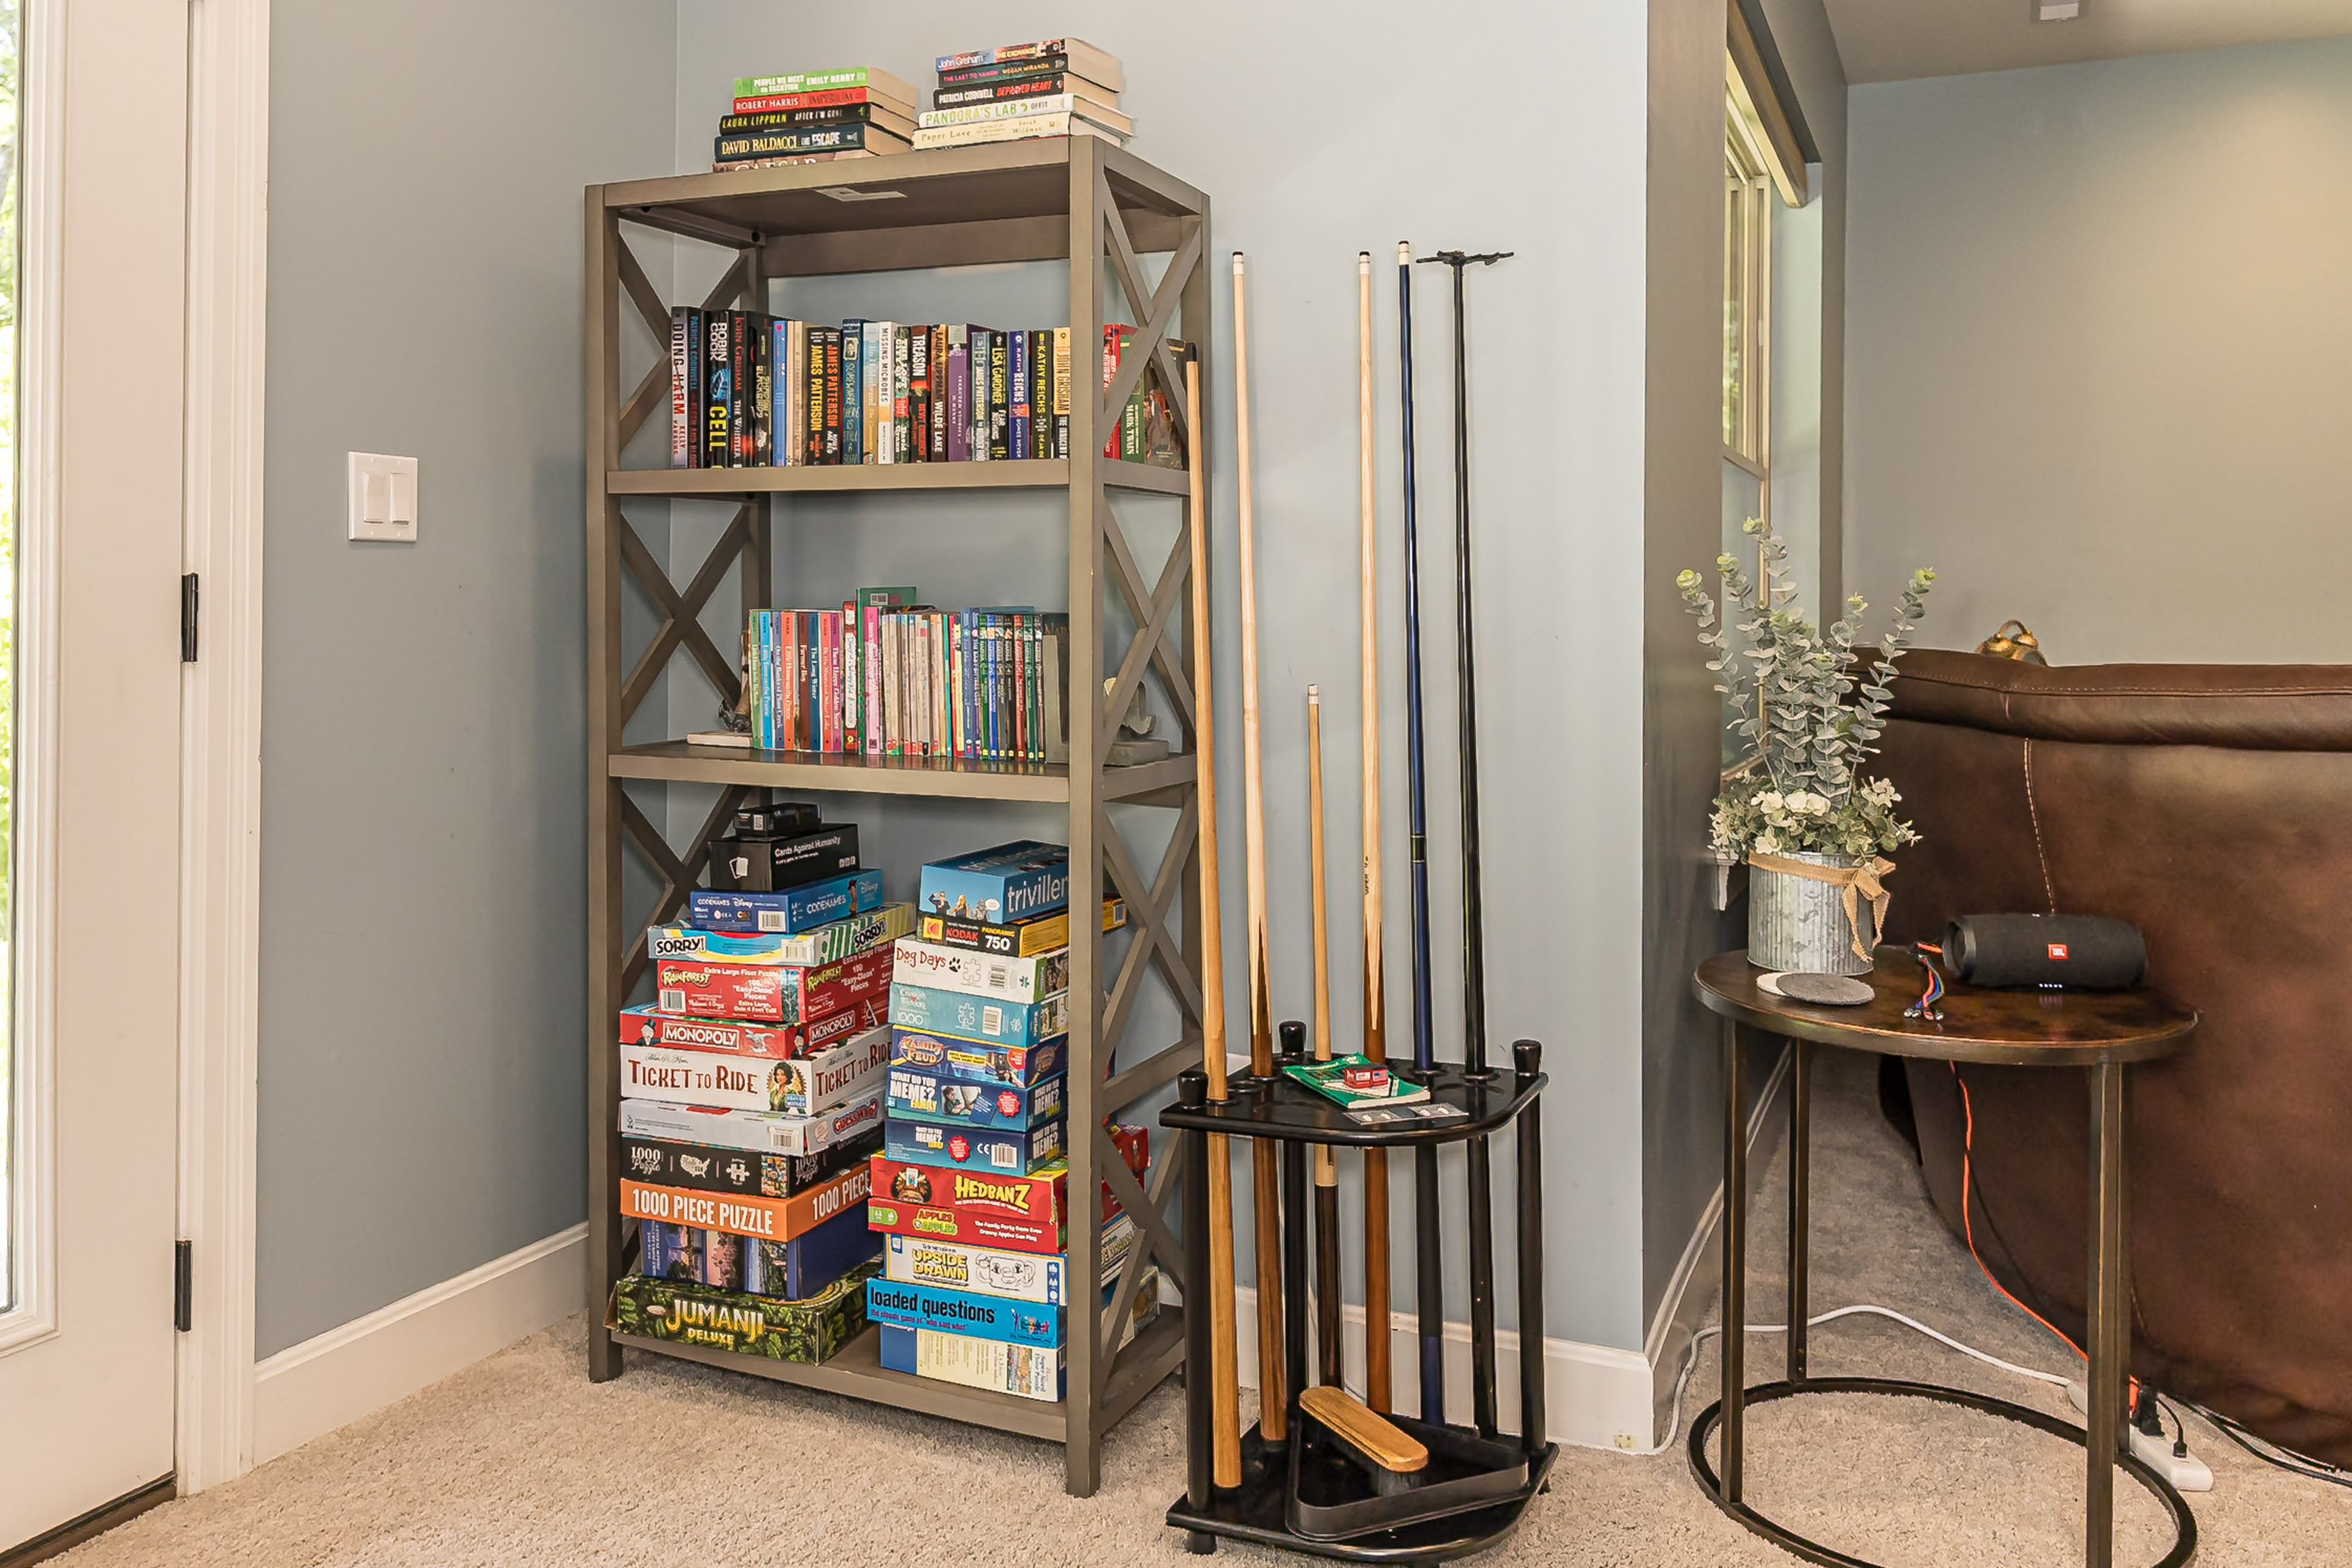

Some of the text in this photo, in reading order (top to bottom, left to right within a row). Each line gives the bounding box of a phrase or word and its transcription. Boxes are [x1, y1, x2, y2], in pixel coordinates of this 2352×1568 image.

[938, 55, 983, 68] John Grisham
[1024, 63, 1049, 71] MIRANDA
[754, 77, 786, 87] PEOPLE WE
[806, 73, 855, 86] EMILY HENRY
[997, 80, 1053, 96] DEPRAVED HEART
[736, 98, 798, 110] ROBERT HARRIS
[809, 93, 853, 106] IMPERIUM
[939, 89, 994, 104] PATRICIA CORNWELL
[1030, 101, 1048, 109] OFFIT
[722, 114, 786, 128] LAURA LIPPMAN
[925, 103, 1017, 126] PANDORA'S LAB
[721, 135, 797, 155] DAVID BALDACCI
[801, 132, 841, 146] THE ESCAPE
[922, 132, 947, 141] Paper
[950, 130, 970, 138] Love
[673, 324, 684, 366] DOING
[710, 323, 718, 361] COOK
[718, 323, 727, 361] ROBIN
[734, 317, 744, 390] JOHN GRISHAM
[912, 334, 925, 375] TREASON
[690, 351, 698, 390] CORNWELL
[935, 332, 943, 400] LAURA LIPPMAN
[827, 345, 838, 426] JAMES PATTERSON
[845, 362, 856, 405] SOMEWHERE
[992, 348, 1003, 404] LISA GARDNER
[1037, 346, 1045, 413] KATHY REICHS
[1057, 354, 1069, 411] JOHN GRISHAM
[811, 345, 822, 431] JAMES PATTERSON
[975, 367, 984, 420] JAMES PATTERSON
[1014, 373, 1023, 402] REICHS
[709, 406, 727, 451] CELL
[934, 401, 943, 453] WILDE LAKE
[1126, 405, 1134, 454] MARK TWAIN
[734, 417, 742, 458] WHISTLER
[775, 837, 841, 857] Cards Against Humanity
[858, 881, 878, 893] Disney
[732, 897, 753, 908] Disney
[806, 895, 846, 914] CODENAMES
[854, 921, 886, 947] SORRY!
[946, 928, 978, 941] KODAK
[982, 927, 1015, 937] PANORAMIC
[656, 937, 706, 954] SORRY!
[985, 935, 1011, 951] 750
[897, 946, 947, 971] Dog Days
[663, 971, 710, 986] RAINFOREST
[897, 1011, 923, 1025] 1000
[664, 1028, 737, 1046] MONOPOLY
[811, 1015, 854, 1043] MONOPOLY
[901, 1036, 944, 1054] FAMILY
[906, 1049, 937, 1062] FEUD
[628, 1059, 759, 1094] TICKET TO RIDE
[816, 1059, 856, 1097] TICKET
[858, 1060, 869, 1075] TO
[890, 1071, 936, 1086] WHAT DO YOU
[889, 1081, 936, 1101] MEME?
[910, 1099, 937, 1112] FAMILY
[833, 1112, 858, 1133] GUESS
[916, 1132, 942, 1143] MEME?
[631, 1146, 660, 1161] 1000
[955, 1175, 1032, 1209] HEDBANZ
[633, 1188, 773, 1234] 1000 PIECE PUZZLE
[812, 1190, 839, 1220] 1000
[919, 1210, 951, 1221] APPLES
[923, 1222, 956, 1234] APPLES
[998, 1231, 1014, 1240] Apples
[912, 1248, 967, 1266] UPSIDE
[914, 1263, 968, 1281] DRAWN
[870, 1287, 995, 1323] loaded questions
[666, 1299, 764, 1343] JUMANJI
[687, 1327, 734, 1346] DELUXE
